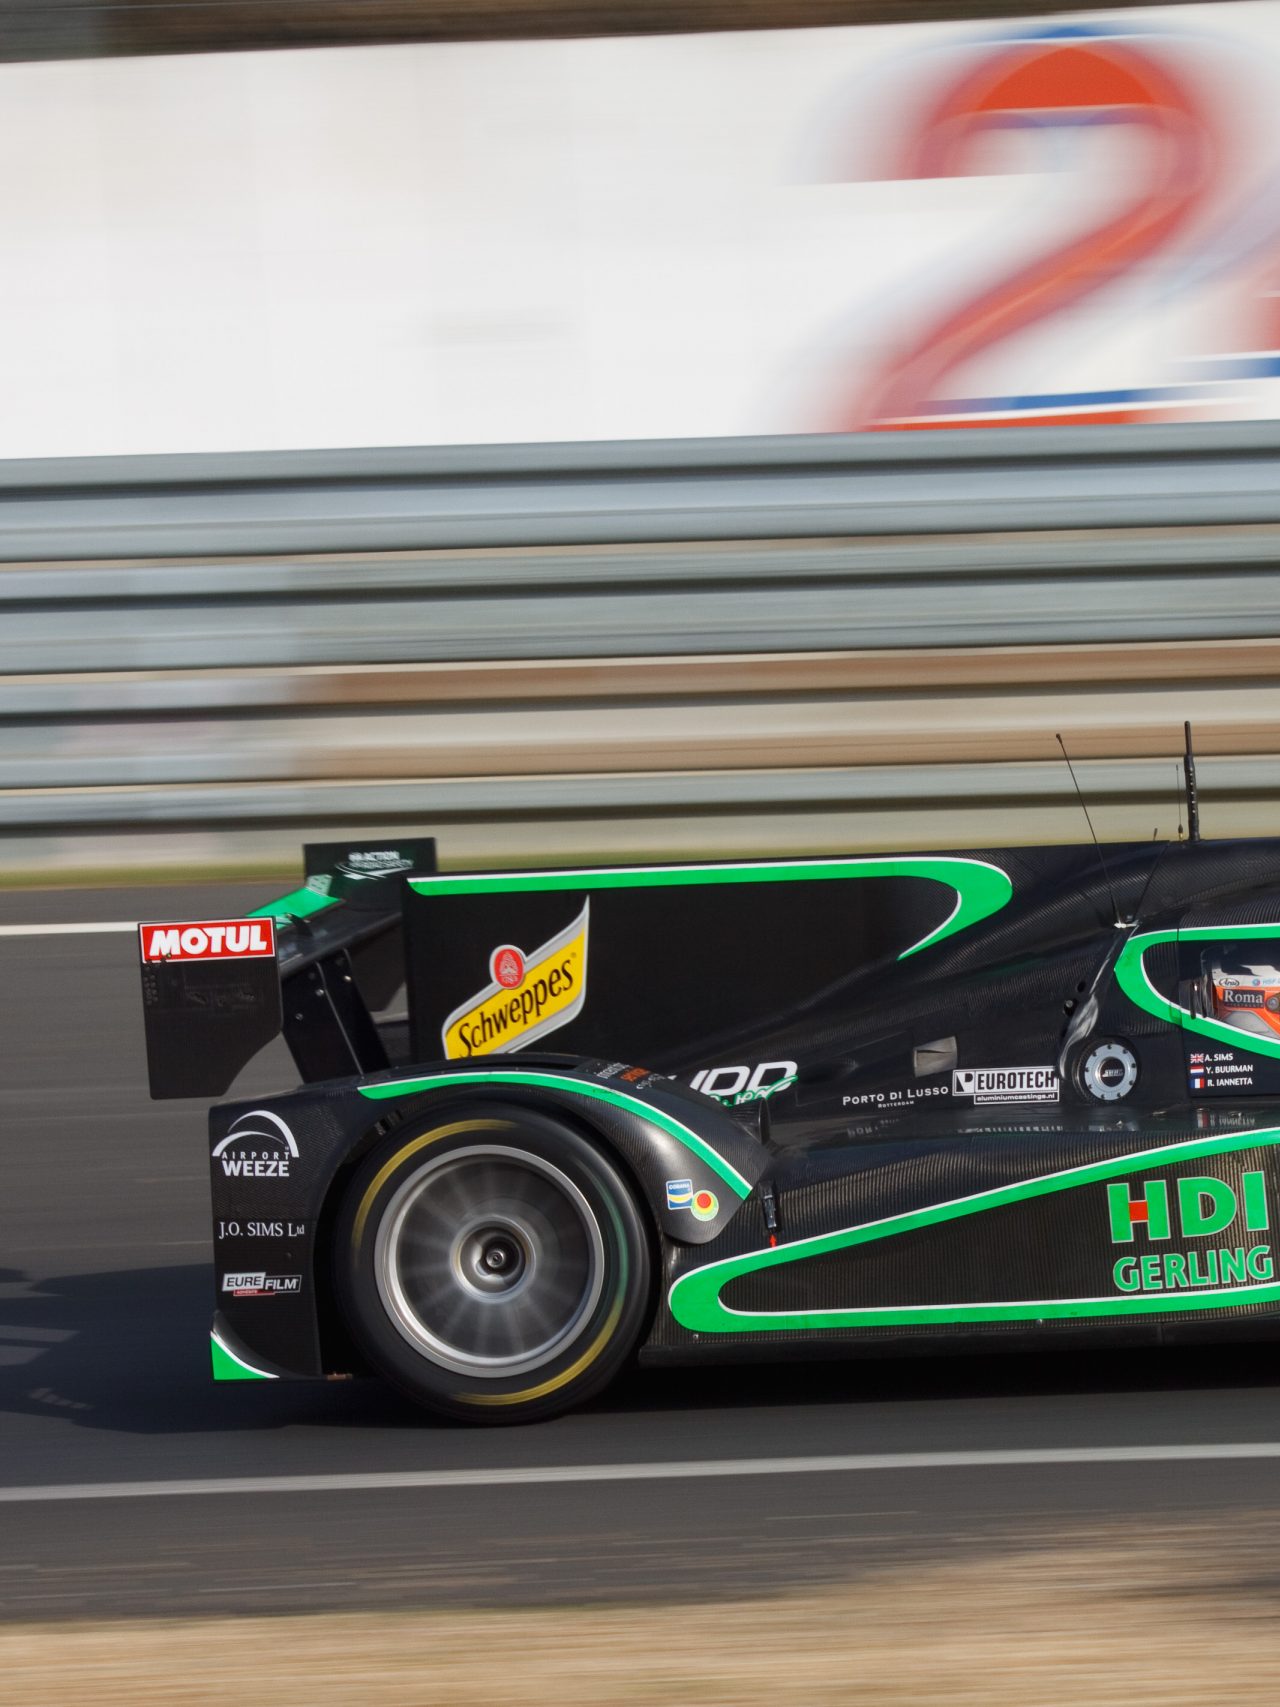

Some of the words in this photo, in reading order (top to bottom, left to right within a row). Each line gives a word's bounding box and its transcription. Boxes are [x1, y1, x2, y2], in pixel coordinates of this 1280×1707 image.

[150, 925, 267, 956] MOTUL
[1224, 989, 1263, 1004] Roma
[458, 959, 573, 1058] Schweppes
[1204, 1053, 1213, 1062] A.
[1213, 1053, 1234, 1061] SIMS
[1205, 1066, 1214, 1074] Y.
[1215, 1064, 1254, 1074] BUURMAN
[977, 1070, 1055, 1090] EUROTECH
[1207, 1079, 1215, 1087] R.
[1216, 1077, 1253, 1087] IANNETTA
[842, 1084, 885, 1106] PORTO
[889, 1081, 903, 1099] DI
[907, 1076, 949, 1098] LUSSO
[221, 1151, 290, 1160] AIRPORT
[221, 1160, 290, 1177] WEEZE
[1107, 1170, 1270, 1244] HDI
[219, 1221, 244, 1239] J.O.
[247, 1221, 284, 1237] SIMS
[287, 1222, 305, 1237] Ltd
[1112, 1244, 1274, 1292] GERLING
